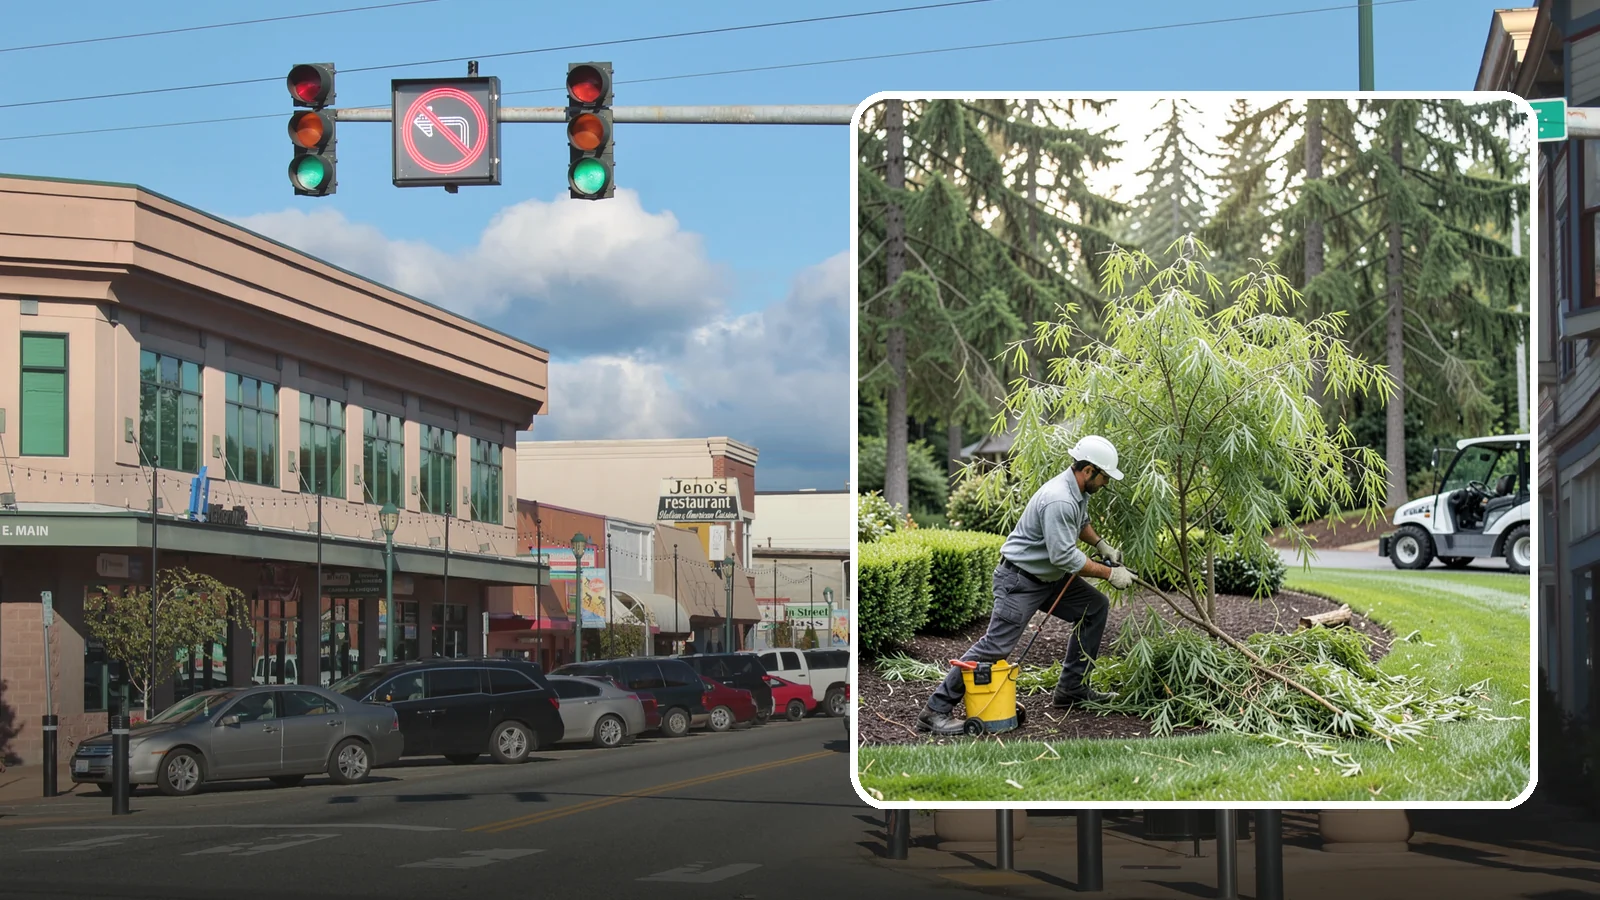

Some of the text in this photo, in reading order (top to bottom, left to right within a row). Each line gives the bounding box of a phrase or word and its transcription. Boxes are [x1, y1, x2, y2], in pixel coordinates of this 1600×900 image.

[669, 480, 727, 494] Jeno's
[665, 496, 731, 509] restaurant
[658, 509, 681, 519] Italian
[685, 509, 714, 519] American
[714, 509, 738, 519] Cuisine
[2, 525, 49, 536] E. MAIN
[797, 608, 828, 617] Street
[791, 619, 823, 627] lass
